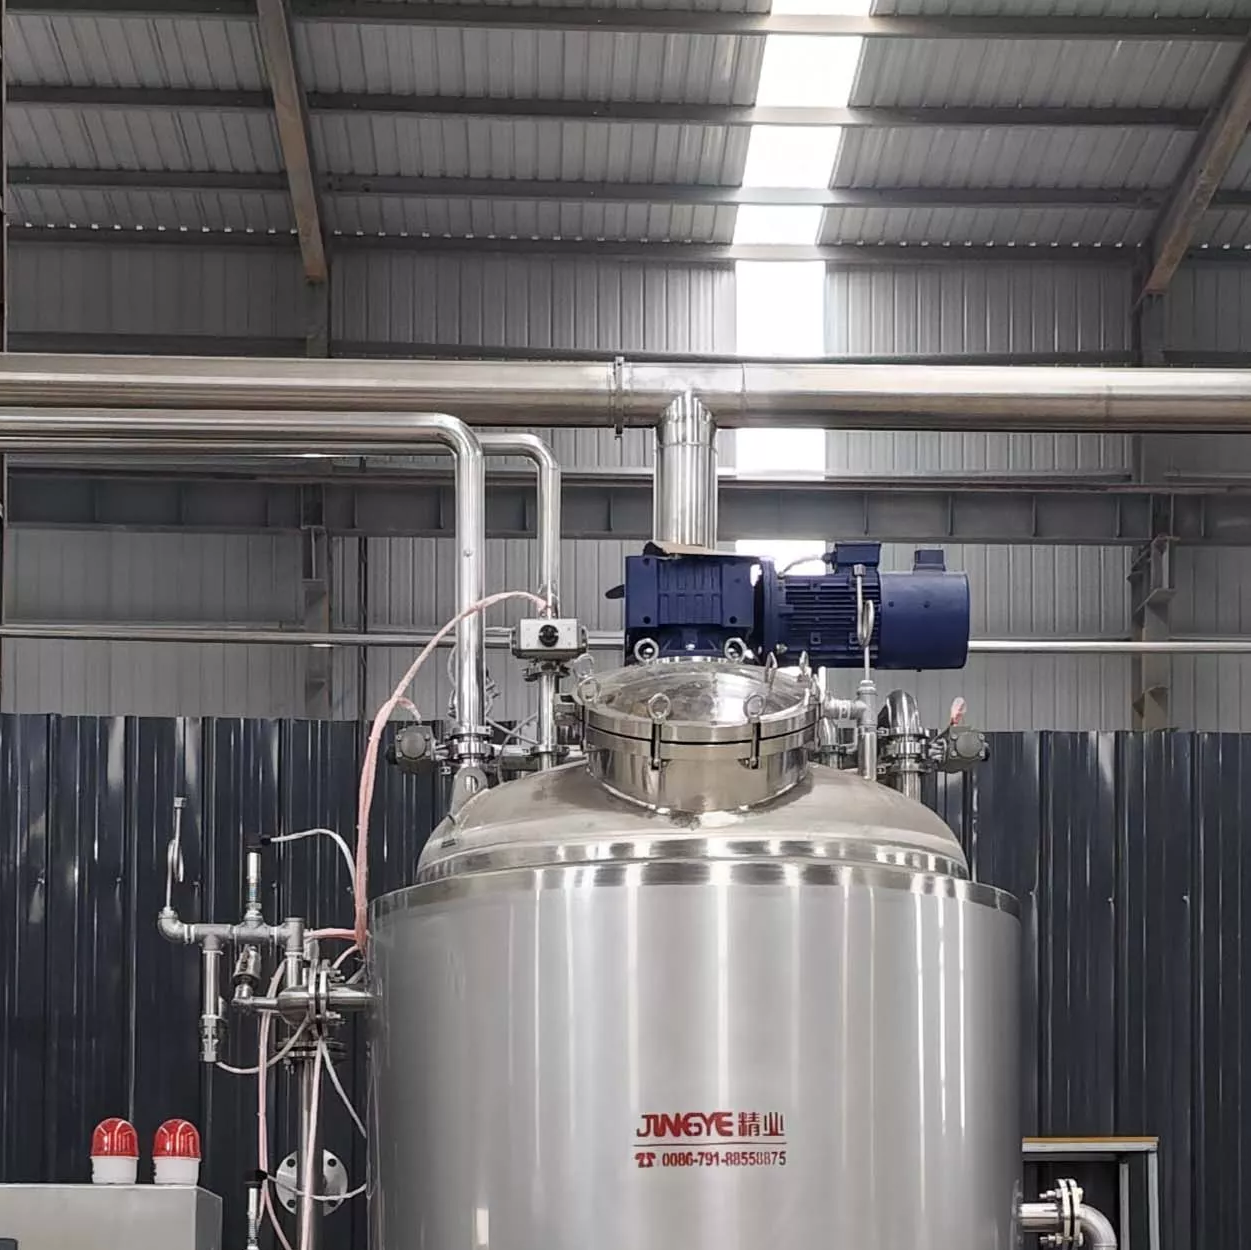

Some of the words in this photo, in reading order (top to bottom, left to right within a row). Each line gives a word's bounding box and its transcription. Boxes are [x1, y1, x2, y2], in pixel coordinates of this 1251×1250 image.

[636, 1112, 734, 1138] JINGYE
[737, 1111, 785, 1137] 精业
[662, 1151, 787, 1167] 0086-791-88558875
